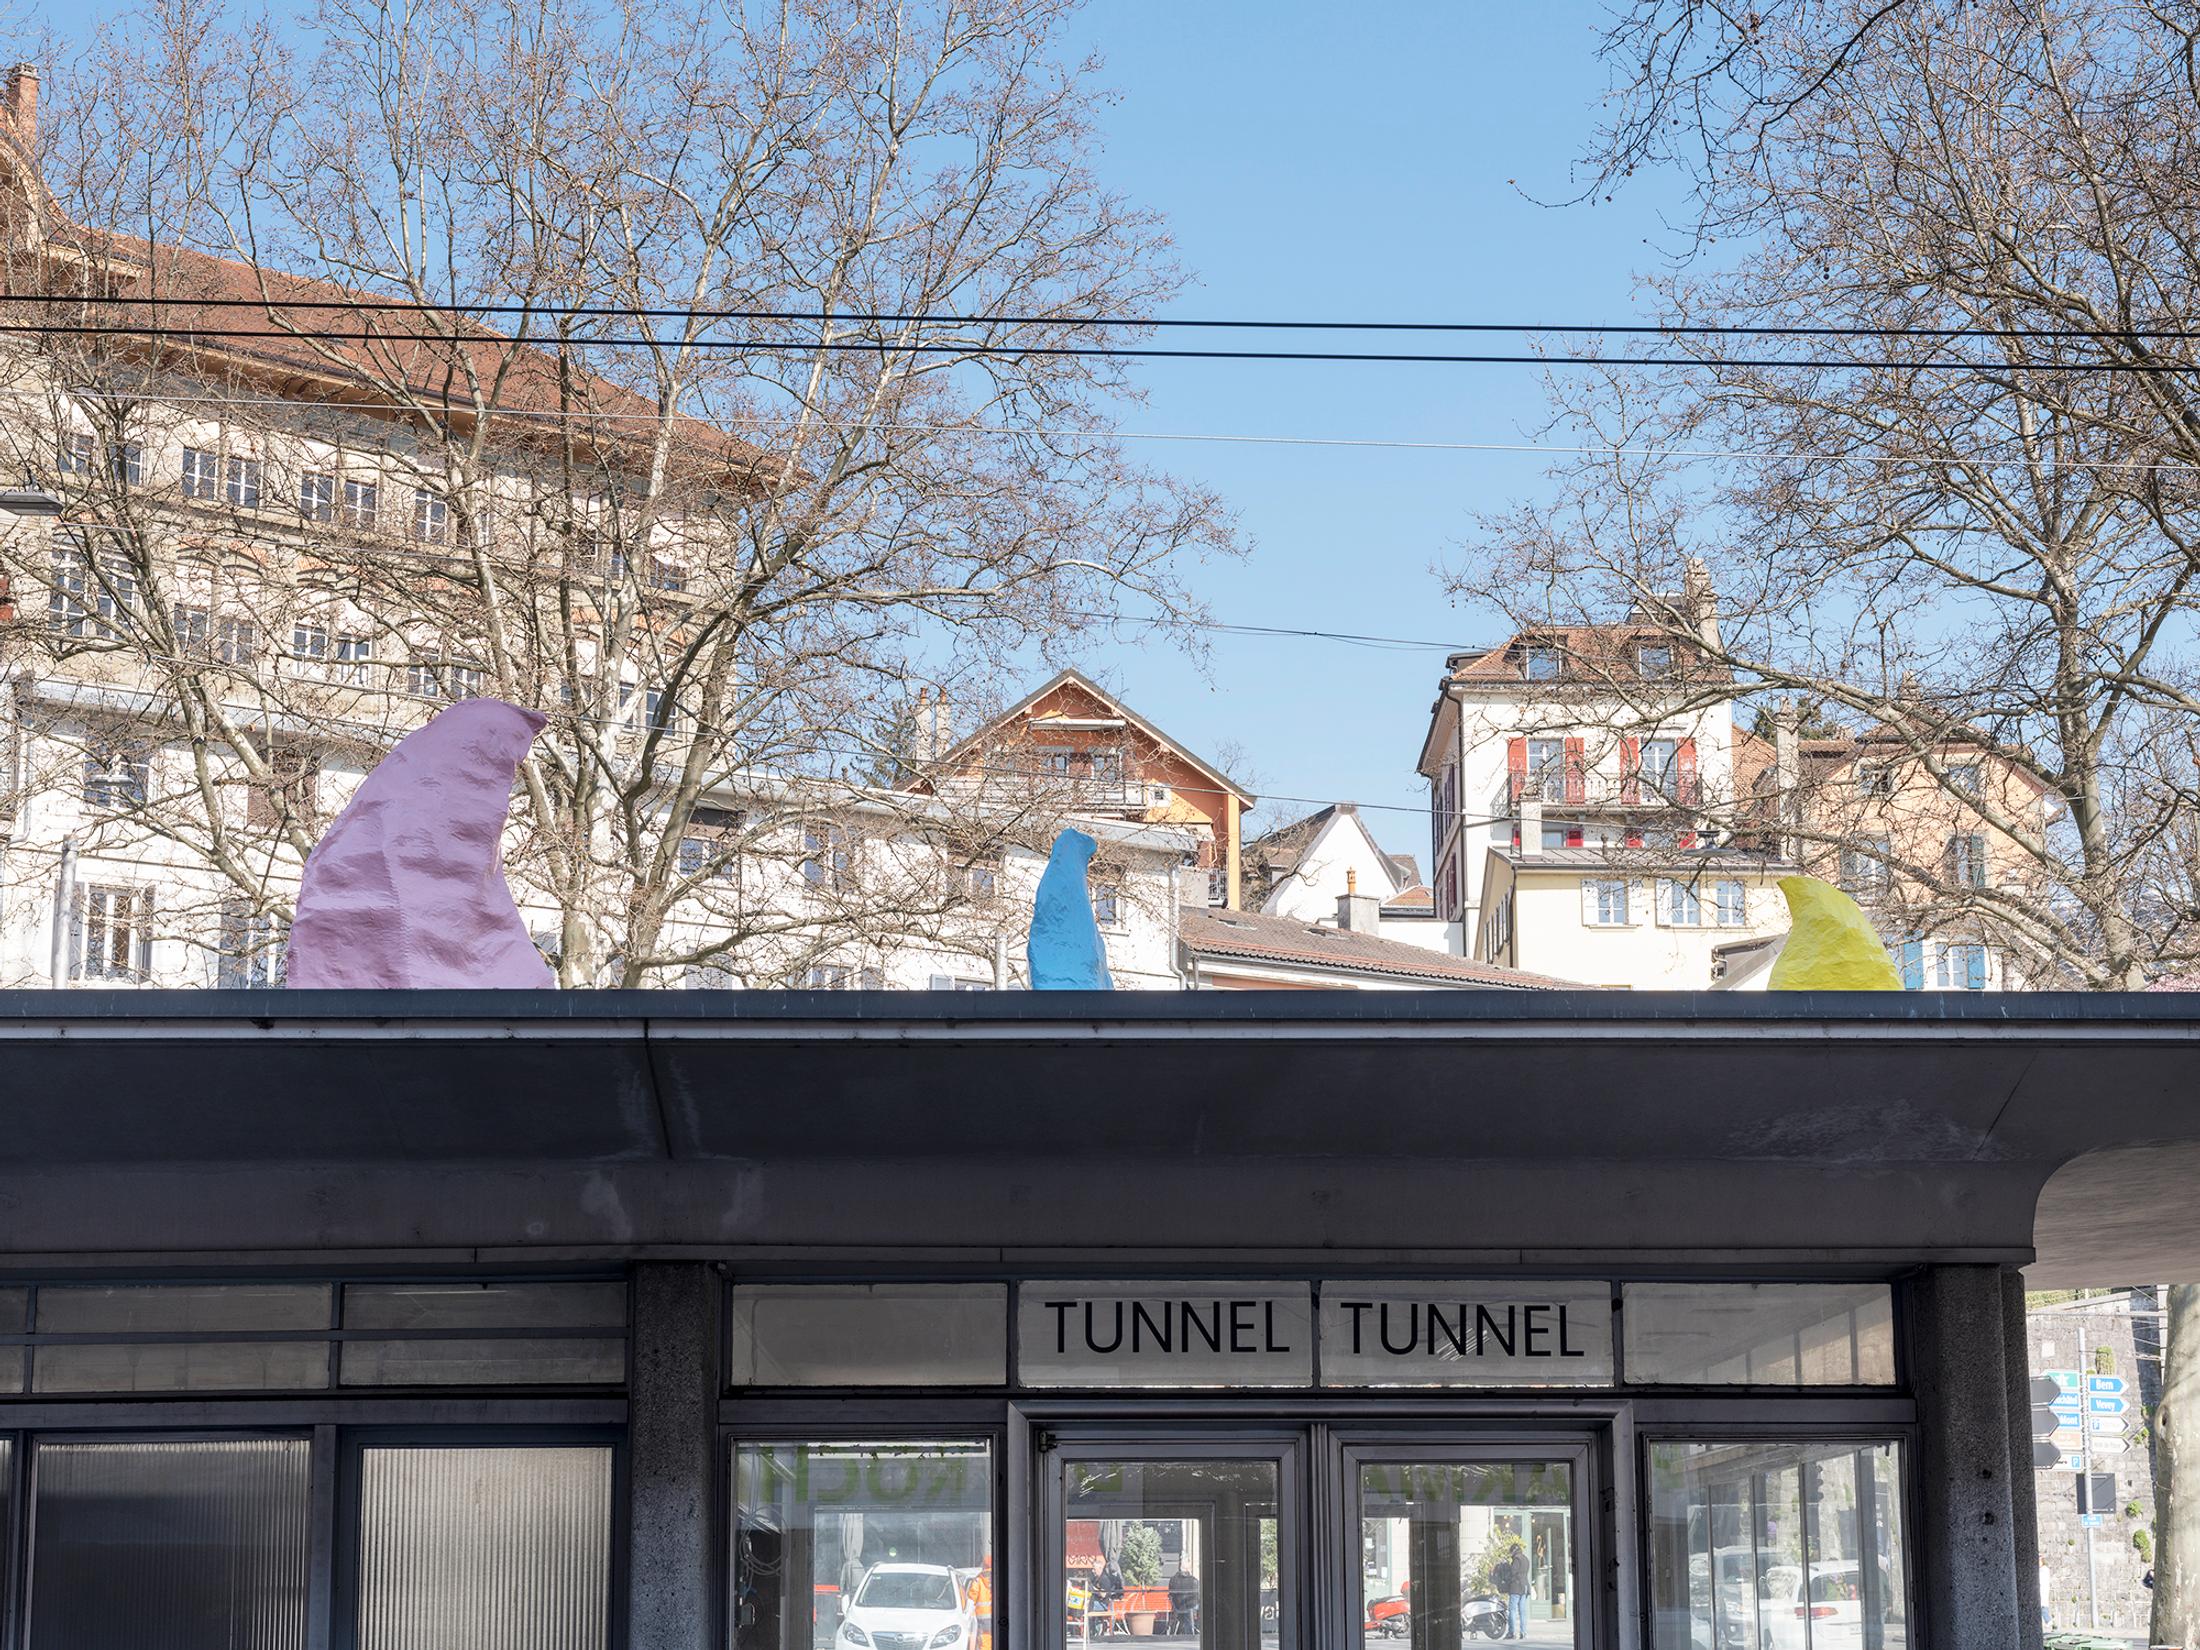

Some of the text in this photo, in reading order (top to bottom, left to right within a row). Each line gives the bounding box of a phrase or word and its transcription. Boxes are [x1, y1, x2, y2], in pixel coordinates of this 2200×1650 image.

[1045, 1301, 1290, 1354] TUNNEL
[1340, 1302, 1585, 1357] TUNNEL
[2095, 1379, 2114, 1390] Bern
[2095, 1399, 2115, 1412] Vevey
